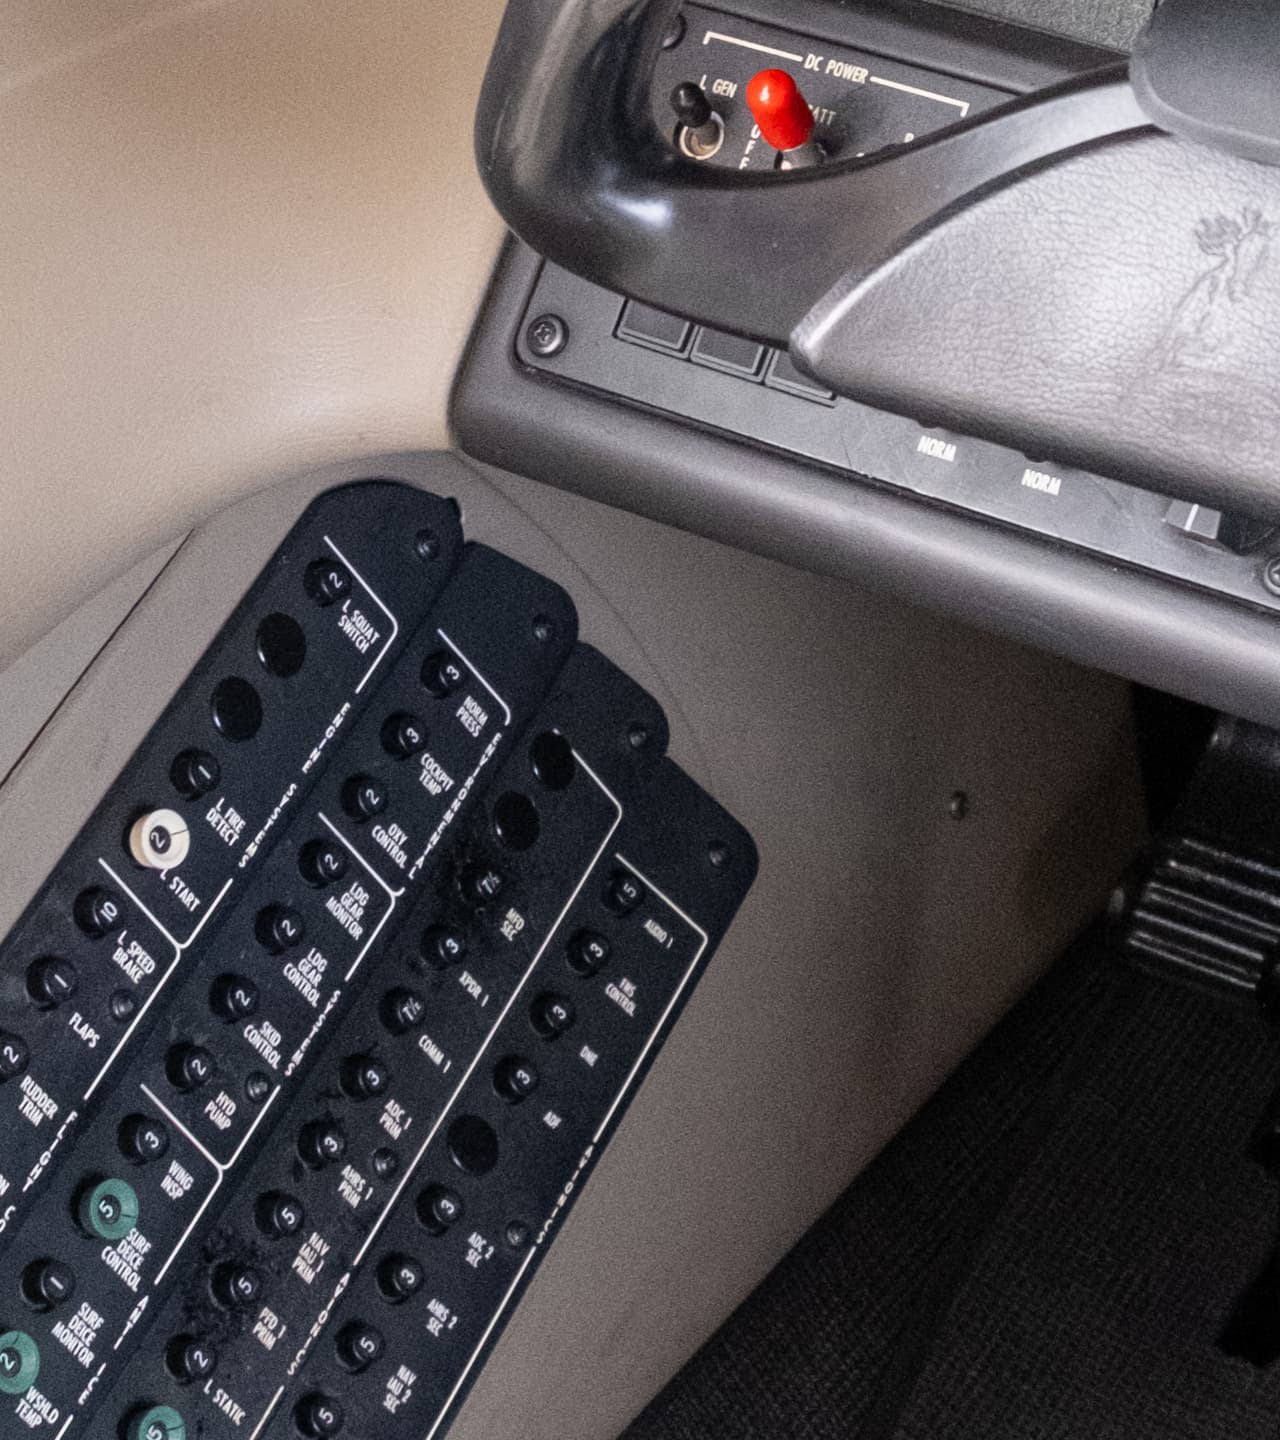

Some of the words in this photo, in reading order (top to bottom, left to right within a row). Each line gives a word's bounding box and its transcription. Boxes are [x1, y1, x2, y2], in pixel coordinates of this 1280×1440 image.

[804, 53, 823, 72] DC
[825, 57, 869, 84] POWER
[699, 74, 708, 90] L
[711, 78, 738, 99] GEN
[917, 434, 957, 463] NORM
[1021, 468, 1061, 497] NORM
[337, 615, 370, 654] SWITCH
[352, 610, 381, 645] SQUAT
[418, 770, 442, 797] TEMP
[420, 752, 455, 791] COCKPIT
[206, 809, 239, 847] DETECT
[225, 807, 246, 834] FIRE
[169, 875, 200, 913] START
[112, 947, 145, 985] BRAKE
[127, 940, 156, 975] SPEED
[69, 1012, 101, 1048] FLAPS
[18, 1095, 45, 1127] TRIM
[20, 1074, 59, 1120] RUDDER
[215, 1090, 237, 1116] HYD
[204, 1099, 232, 1131] PUMP
[160, 1174, 184, 1200] INSP
[168, 1160, 194, 1191] WING
[25, 1385, 60, 1425] WSHLD
[212, 1387, 246, 1427] STATIC
